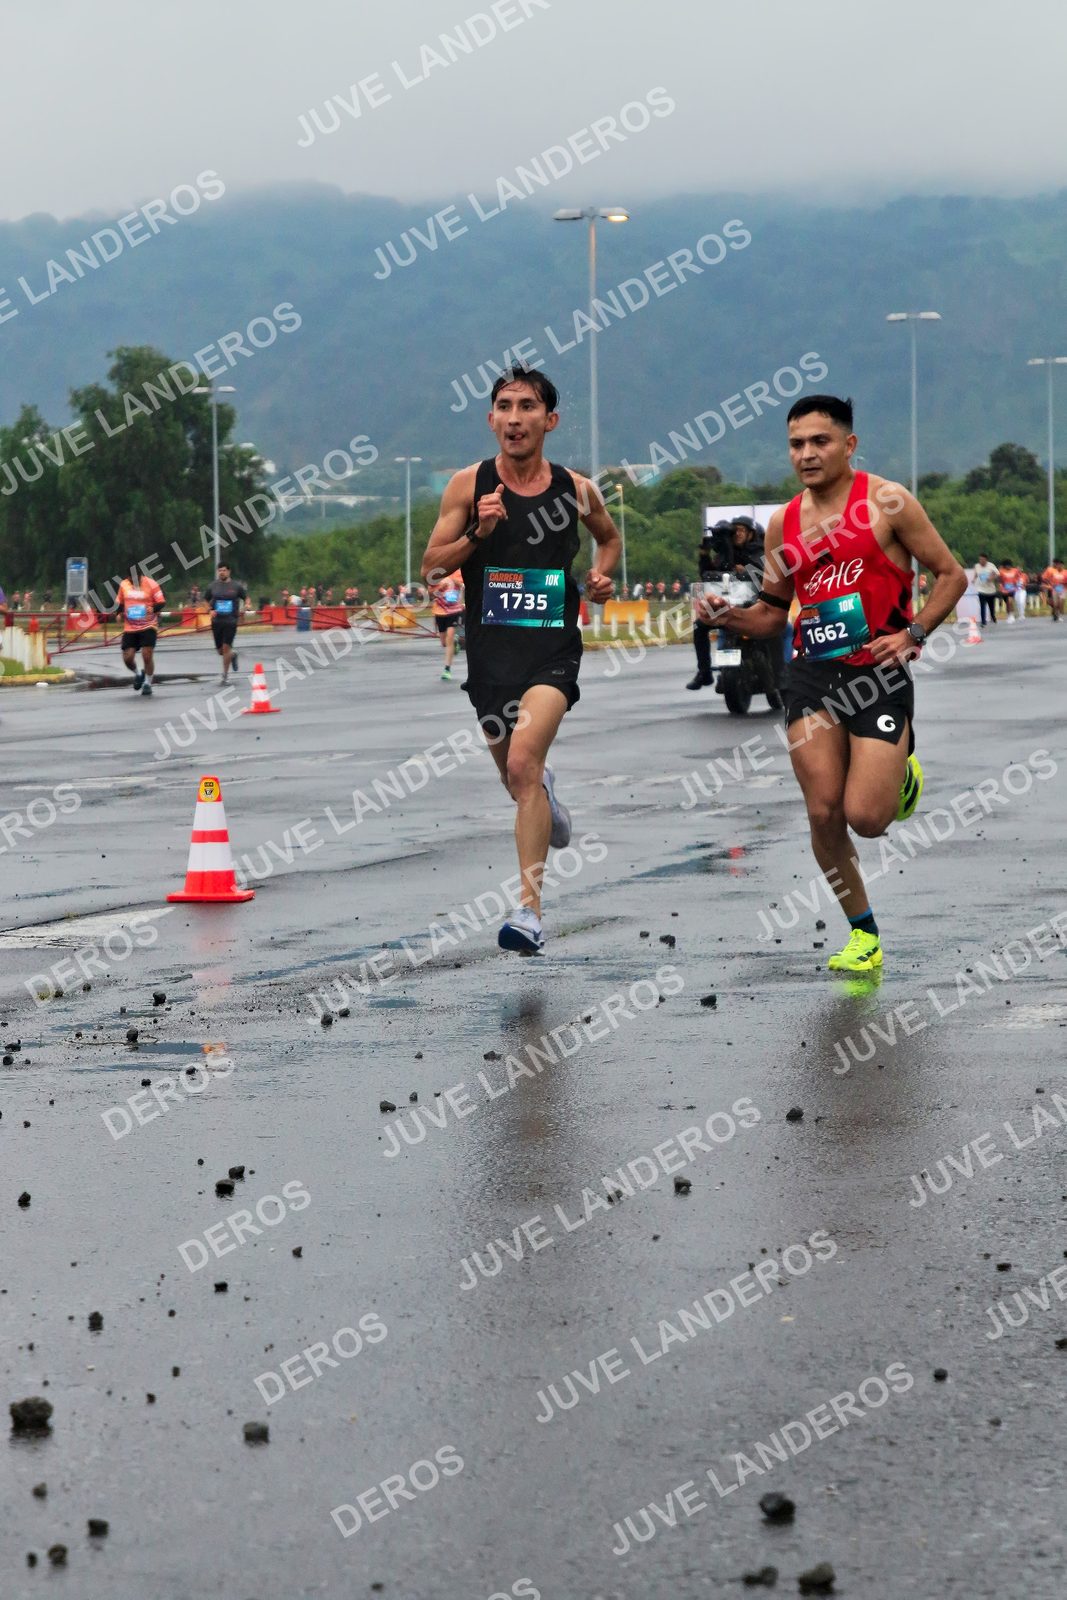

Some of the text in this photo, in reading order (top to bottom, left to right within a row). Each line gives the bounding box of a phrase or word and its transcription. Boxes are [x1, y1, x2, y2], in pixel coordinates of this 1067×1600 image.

[545, 574, 560, 586] 10K
[500, 592, 548, 610] 1735
[839, 598, 854, 612] 10K
[807, 622, 848, 644] 1662
